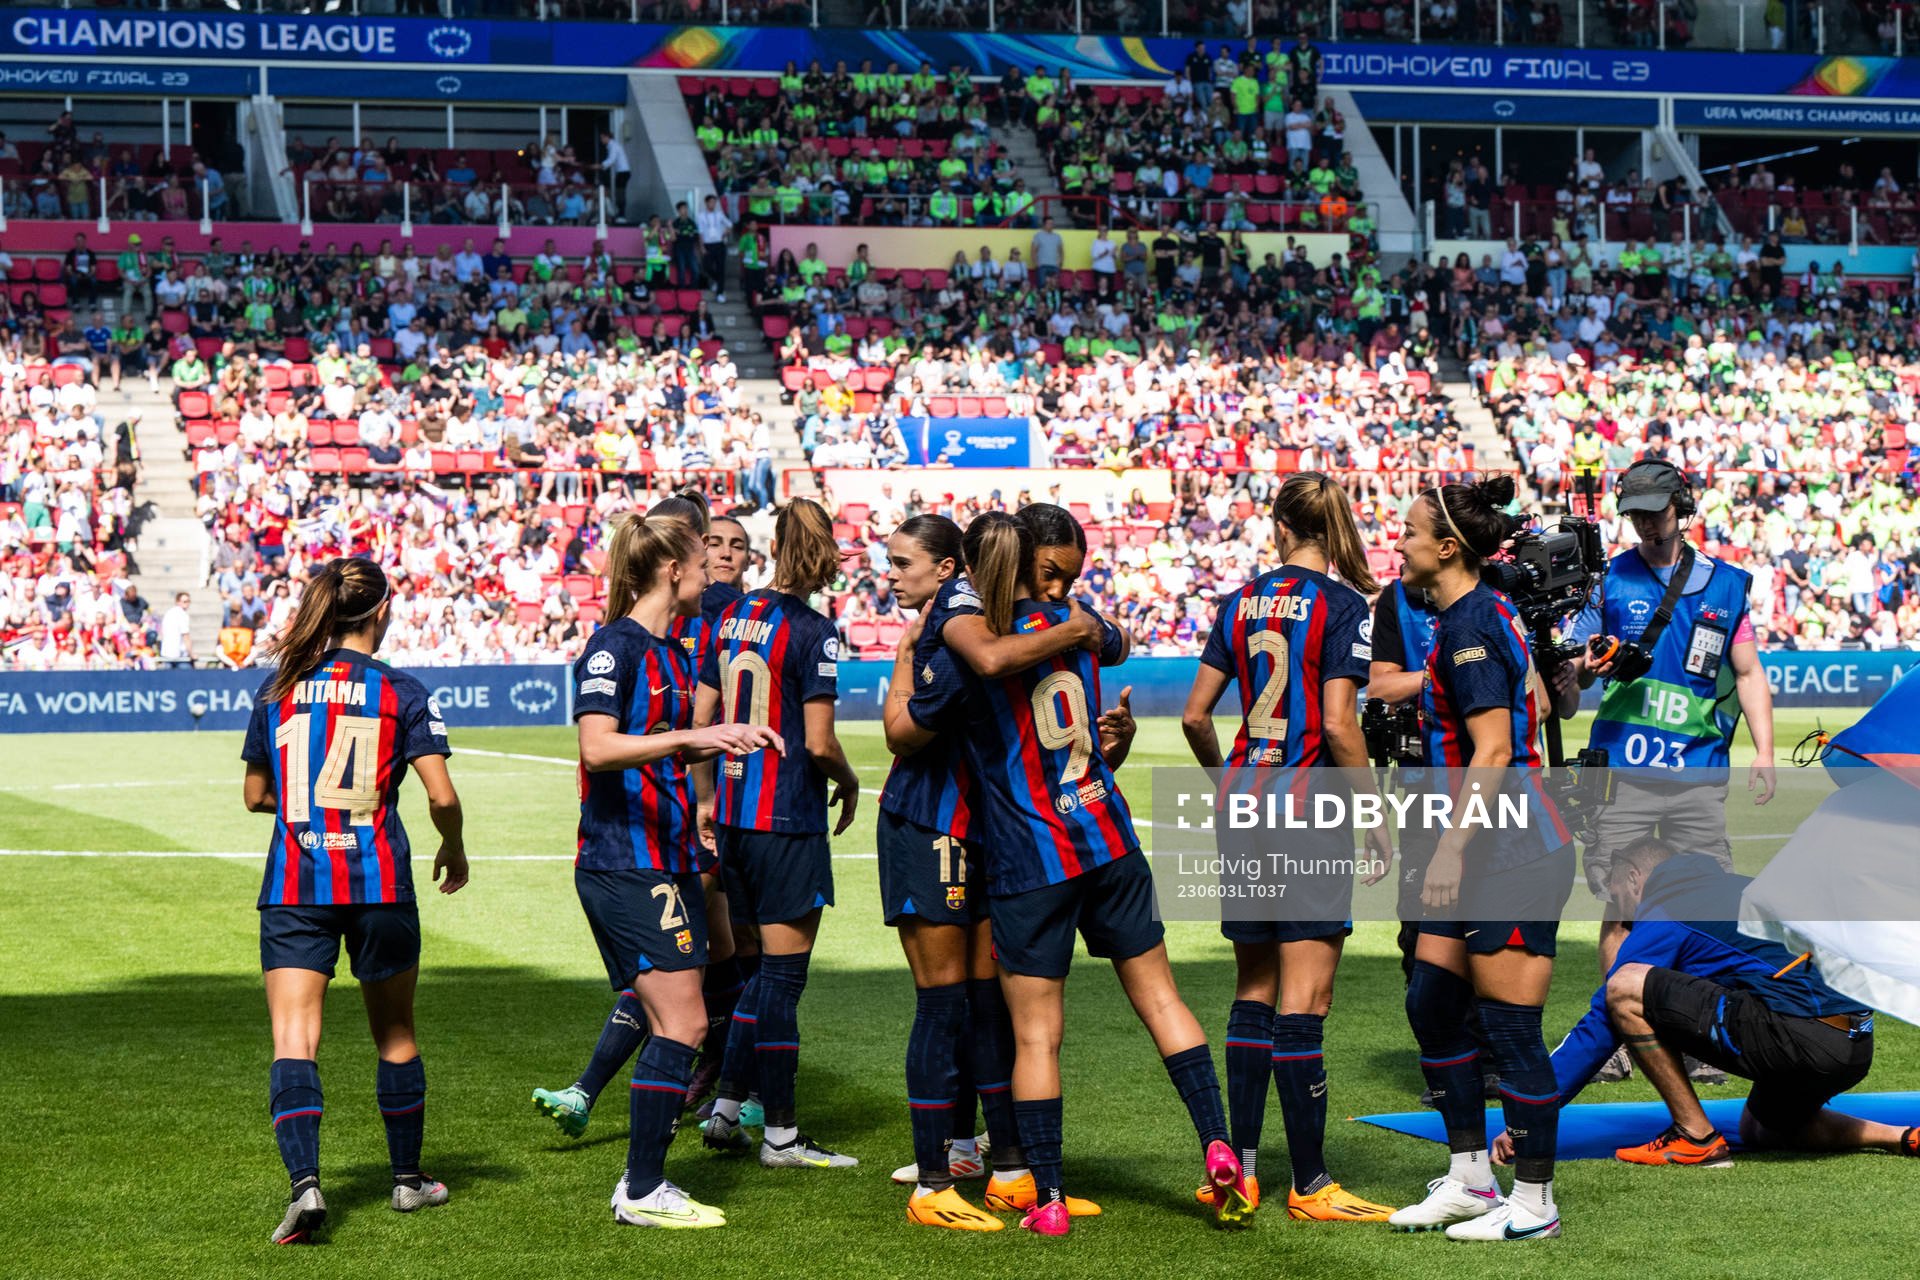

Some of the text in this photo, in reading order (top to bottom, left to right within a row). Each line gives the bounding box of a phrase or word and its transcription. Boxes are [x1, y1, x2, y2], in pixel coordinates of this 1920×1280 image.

[13, 17, 396, 53] CHAMPIONS LEAGUE
[87, 70, 155, 86] FINAL
[161, 72, 190, 86] 23
[1321, 53, 1650, 81] INDHOVEN FINAL 23
[1704, 106, 1920, 124] UEFA WOMEN'S CHAMPIONS LEA
[1238, 596, 1312, 621] PAREDES
[719, 617, 774, 645] GRAHAM
[1454, 648, 1486, 665] BIMBO
[292, 680, 367, 706] AITANA
[1247, 630, 1289, 741] 2
[1766, 664, 1860, 694] PEACE
[36, 690, 177, 714] WOMEN'S
[187, 689, 258, 712] CHA
[717, 649, 771, 754] 10
[1642, 686, 1689, 725] HB
[1031, 670, 1093, 785] 9
[1625, 733, 1687, 773] 023
[275, 712, 382, 827] 14
